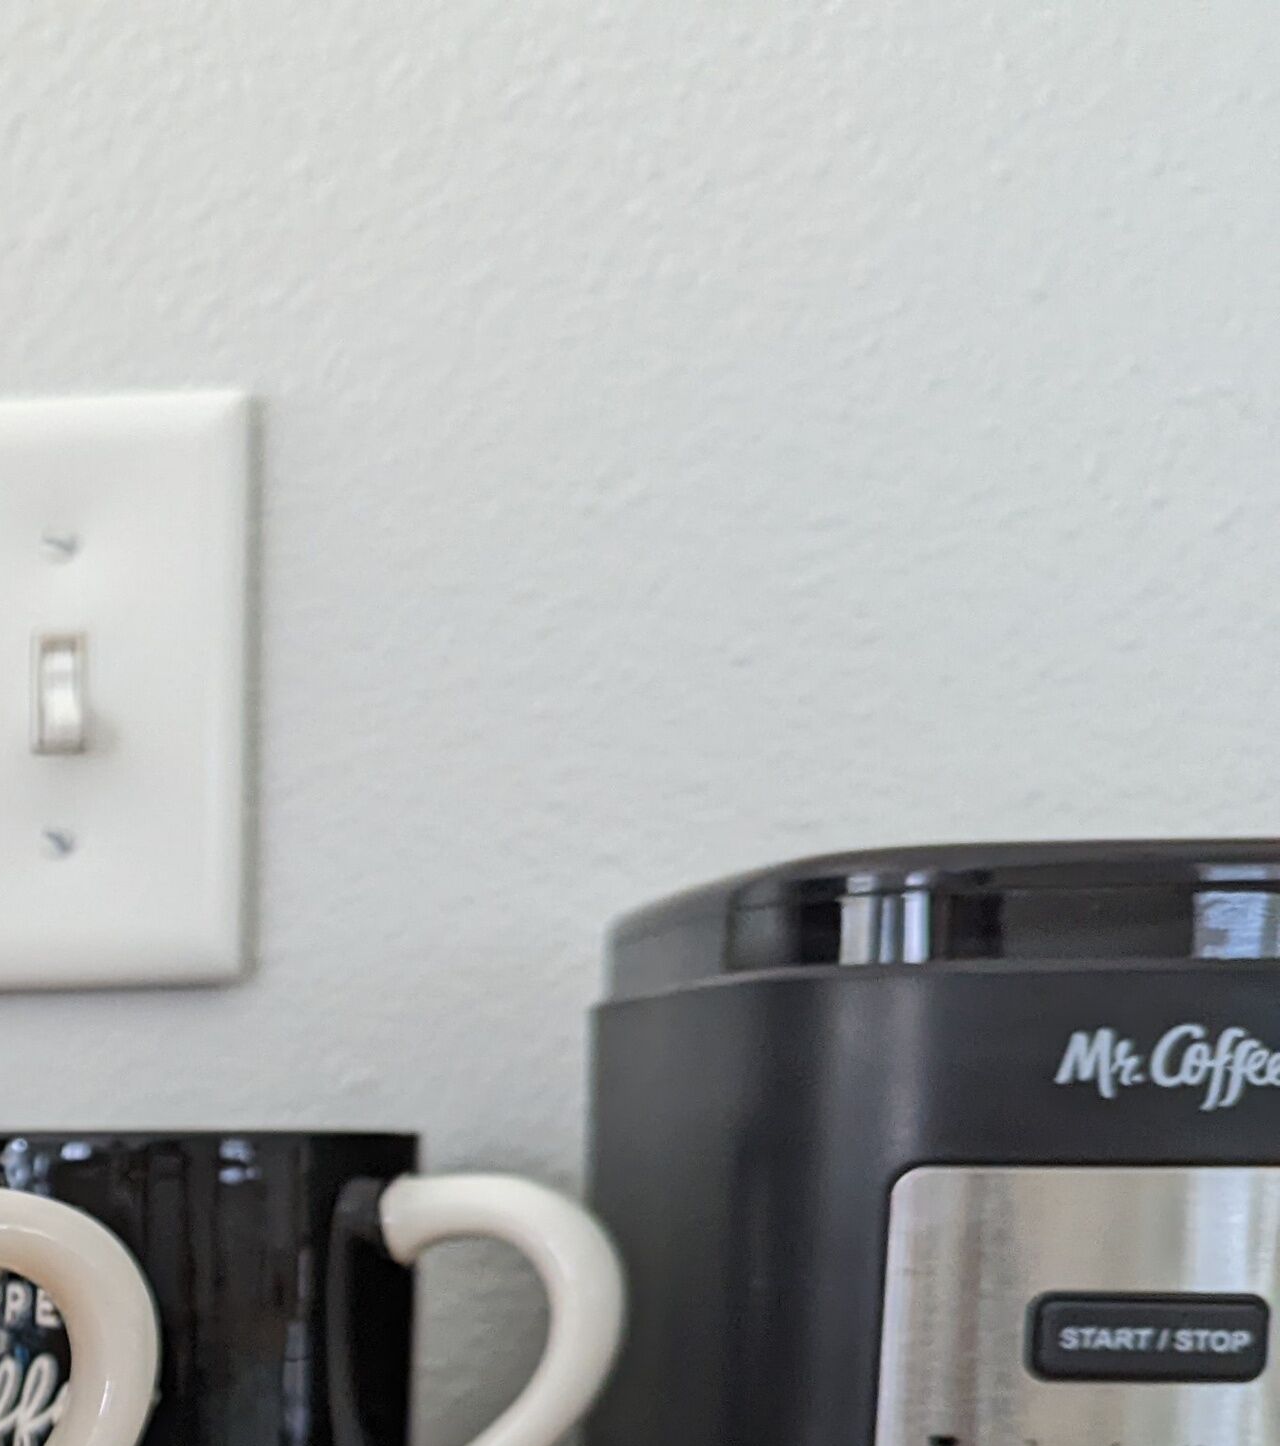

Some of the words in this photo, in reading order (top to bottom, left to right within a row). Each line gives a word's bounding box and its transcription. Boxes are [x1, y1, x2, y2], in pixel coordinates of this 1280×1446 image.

[1053, 1027, 1146, 1100] Mr.
[1058, 1326, 1154, 1351] START
[1172, 1329, 1254, 1354] STOP
